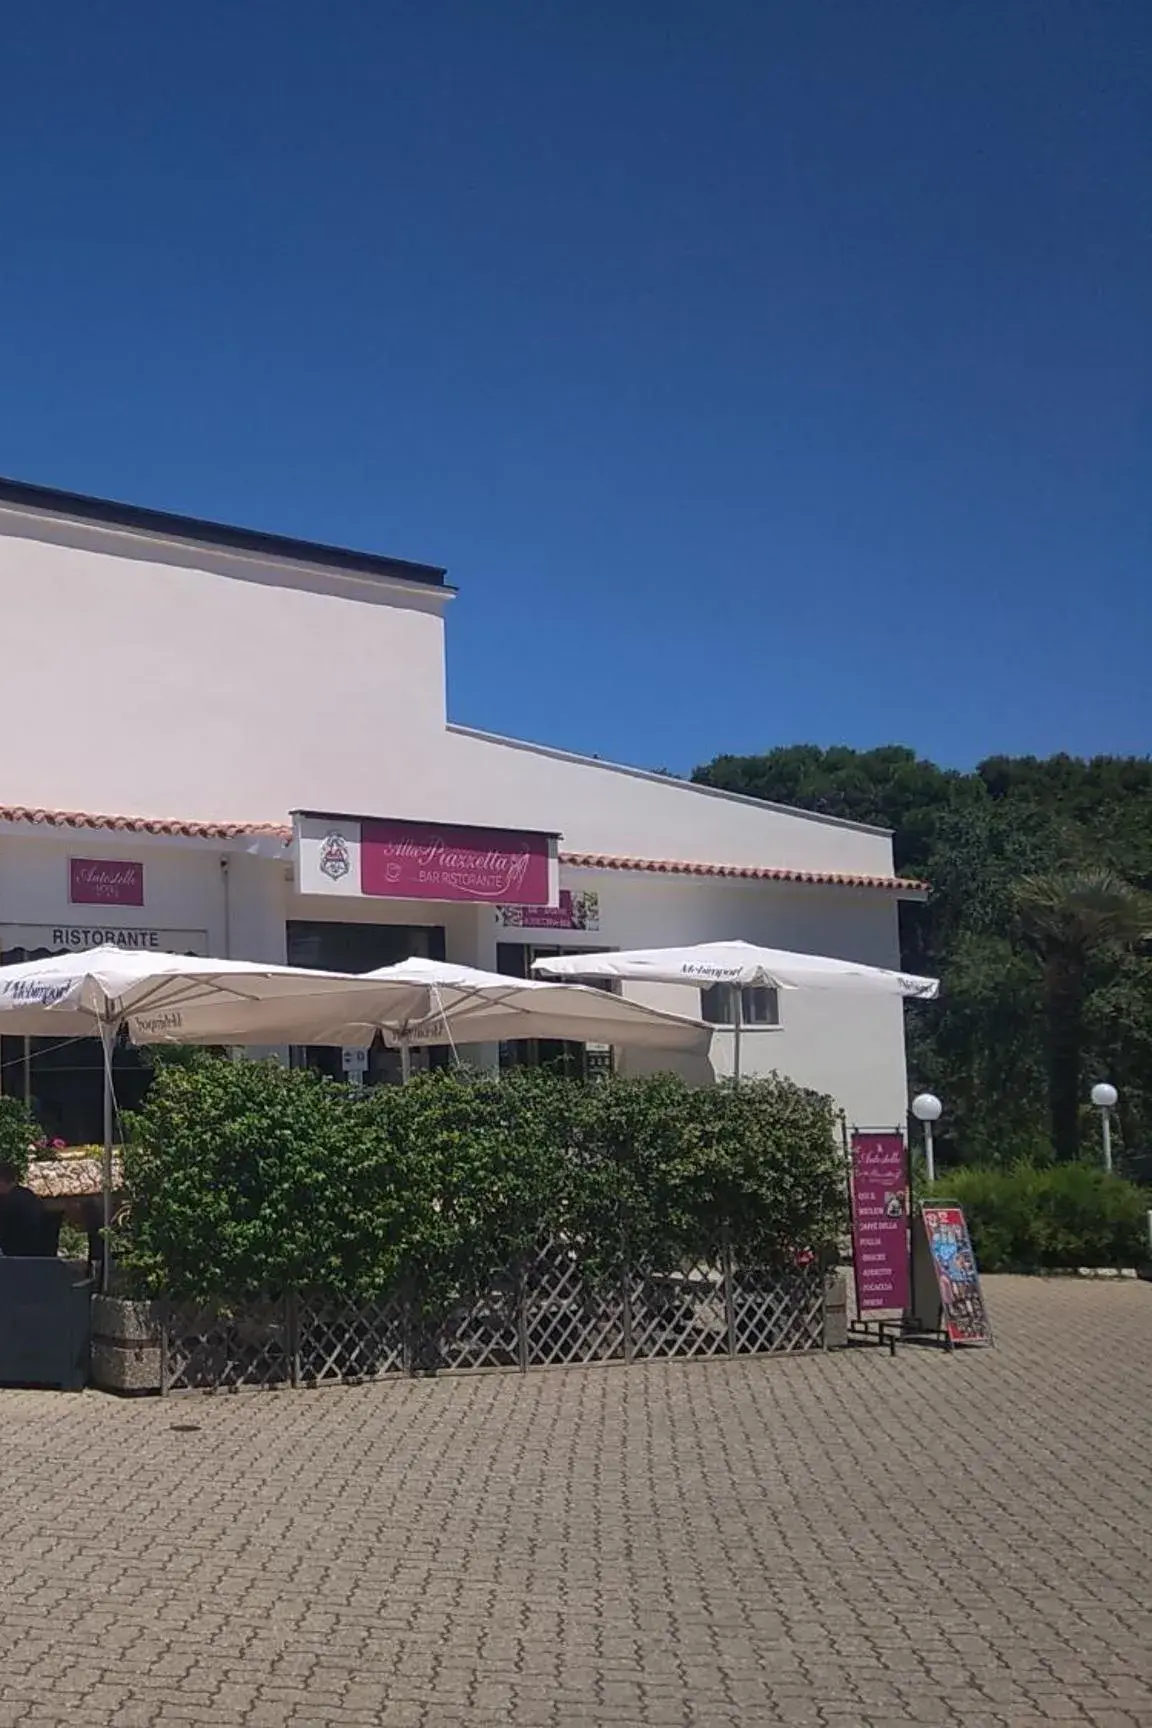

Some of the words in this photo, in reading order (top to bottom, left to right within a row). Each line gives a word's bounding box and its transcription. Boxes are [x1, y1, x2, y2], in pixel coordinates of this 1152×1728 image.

[418, 835, 512, 872] Piazzetta
[419, 870, 440, 884] BAR
[441, 871, 505, 888] RISTORANTE
[52, 929, 159, 947] RISTORANTE
